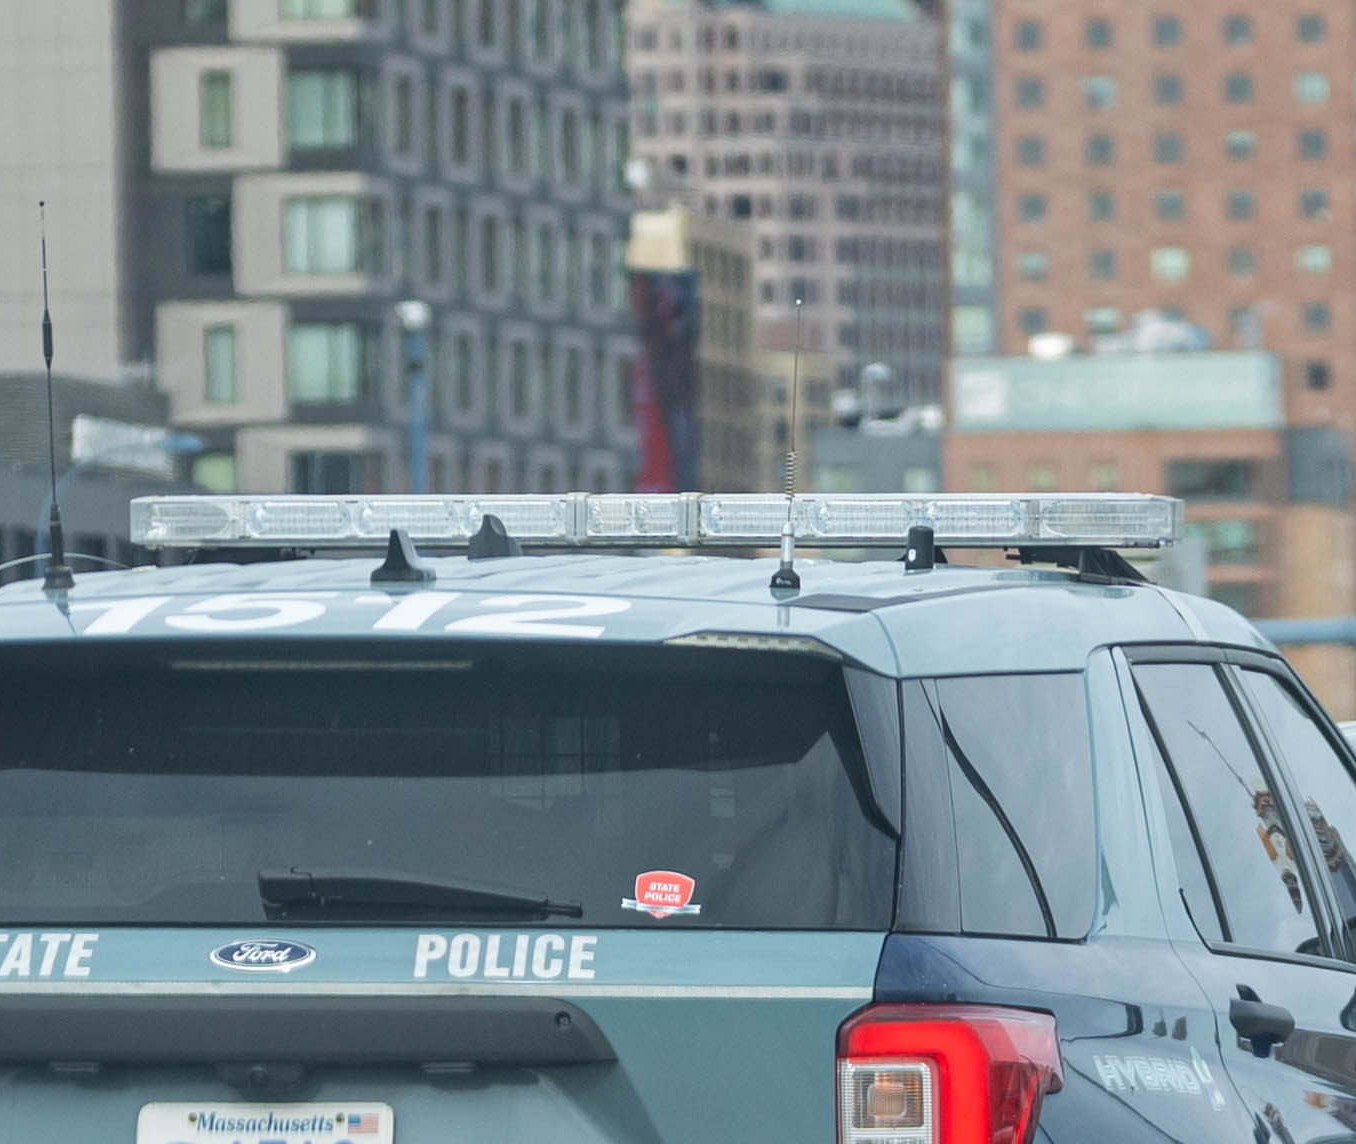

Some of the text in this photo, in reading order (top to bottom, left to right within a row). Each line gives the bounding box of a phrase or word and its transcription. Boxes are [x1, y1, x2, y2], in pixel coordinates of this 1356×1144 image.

[71, 592, 631, 637] 1512
[644, 891, 682, 904] POLICE
[649, 882, 680, 893] STATE
[413, 933, 597, 979] POLICE
[1093, 1056, 1202, 1095] HYBRID
[197, 1111, 334, 1133] Massachusetts
